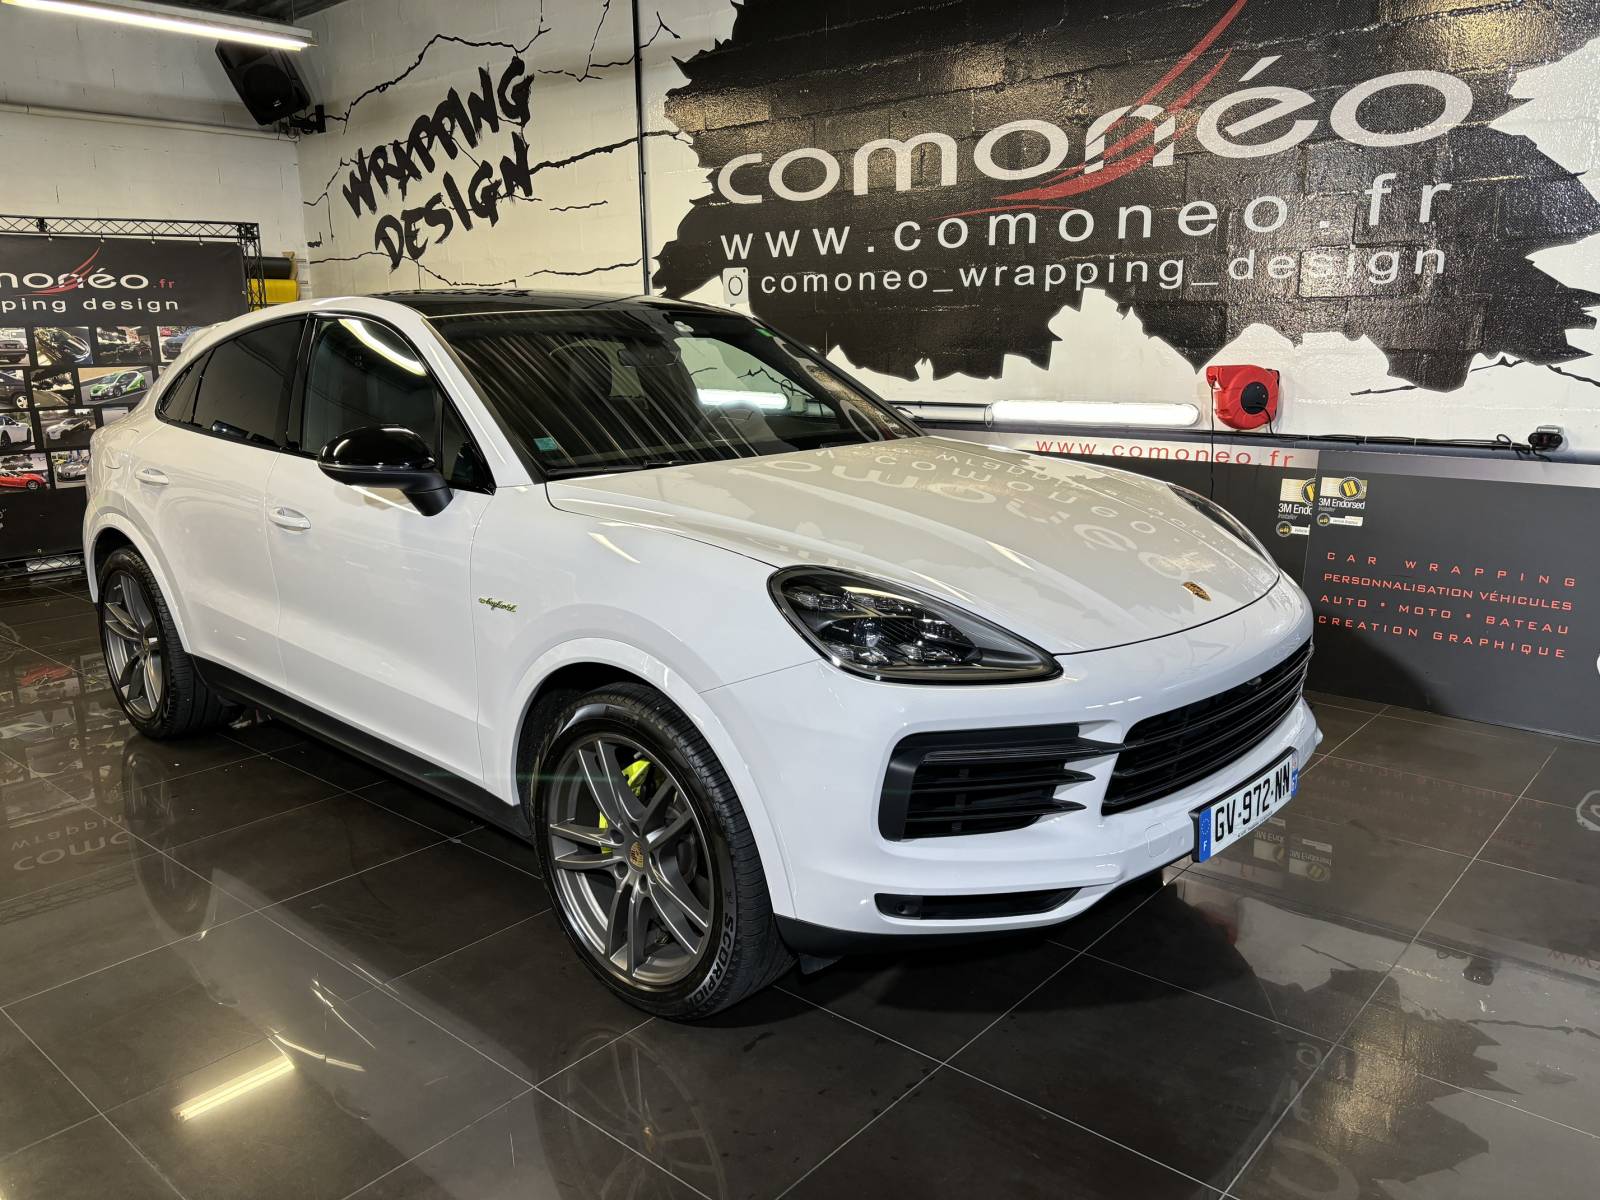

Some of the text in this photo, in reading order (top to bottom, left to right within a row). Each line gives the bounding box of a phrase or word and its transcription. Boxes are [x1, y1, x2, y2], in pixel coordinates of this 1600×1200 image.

[343, 56, 534, 218] WRAPPING
[717, 55, 1474, 204] comonéo
[375, 131, 533, 271] DESIGN
[720, 172, 1453, 260] www.comoneo.fr
[83, 298, 179, 313] design
[1036, 440, 1295, 468] www.comoneo.fr
[1278, 503, 1292, 514] 3M
[1319, 498, 1366, 510] 3M Endorsed
[1327, 552, 1576, 587] CAR WRAPPING
[1324, 573, 1573, 612] PERSONNALISATION VÉHICULES
[1320, 594, 1569, 635] AUTO MOTO BATEAU
[1432, 631, 1566, 658] GRAPHIQUE
[1214, 761, 1290, 842] GV-972-NN
[1203, 840, 1208, 852] F
